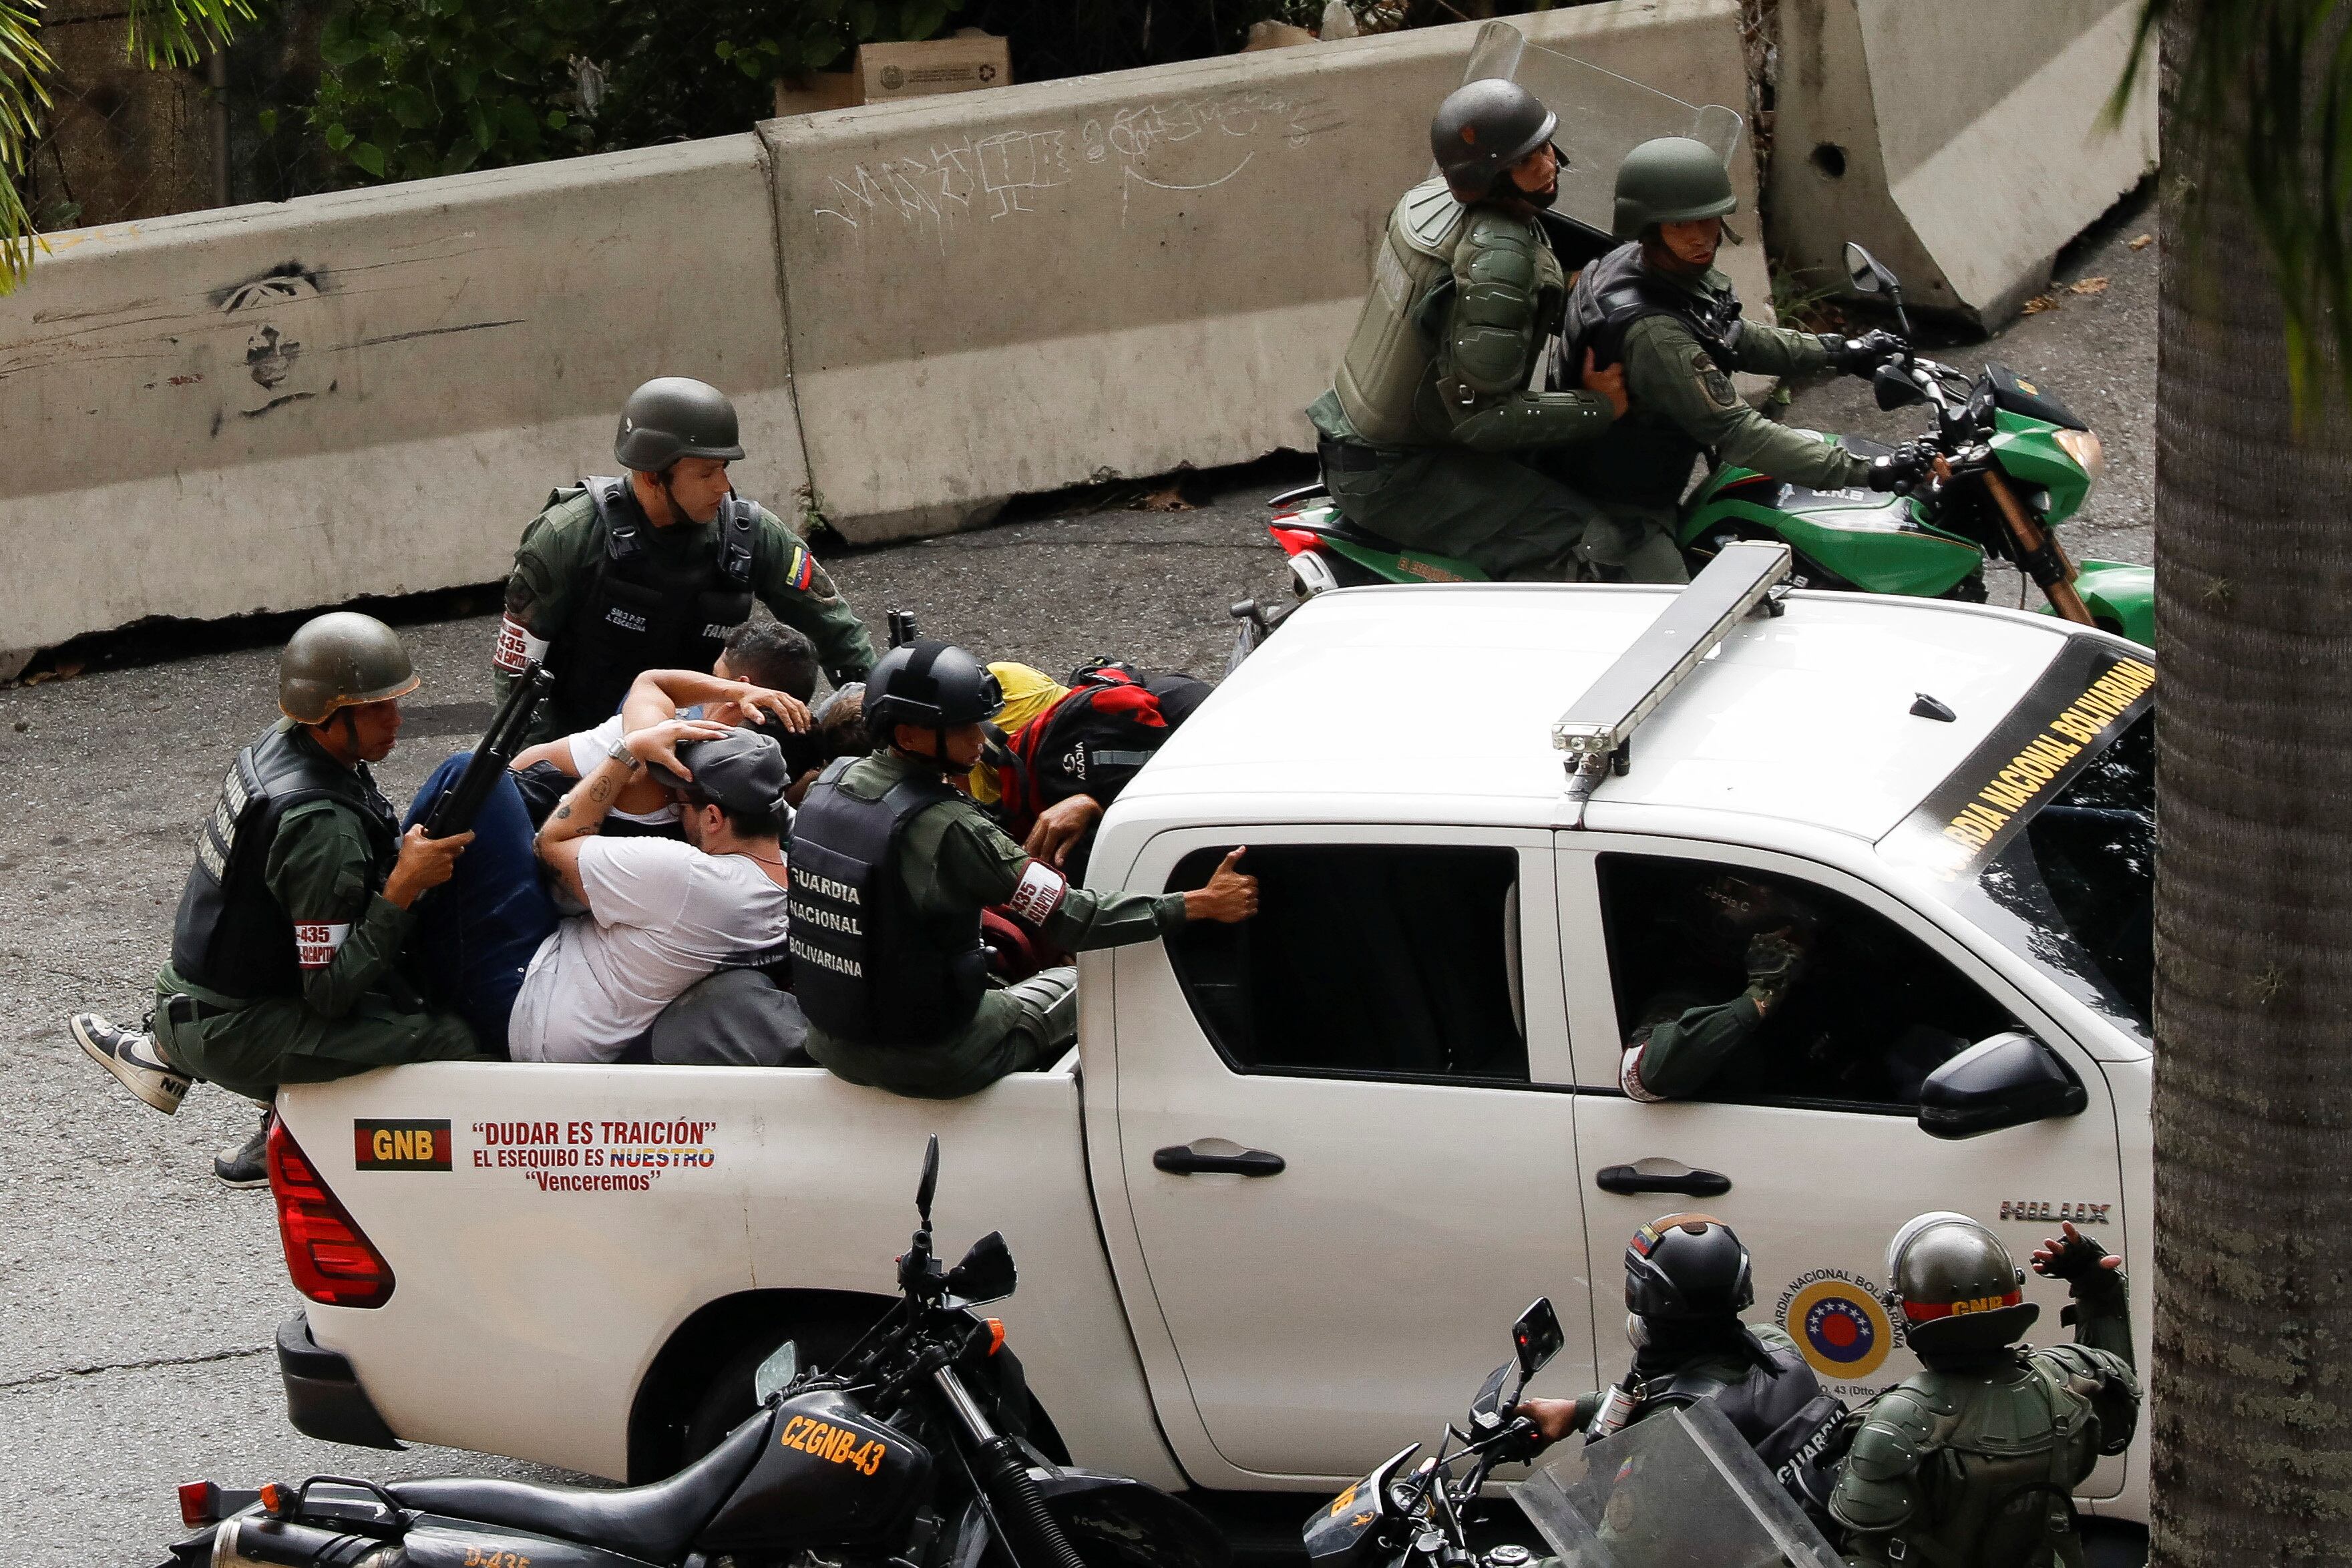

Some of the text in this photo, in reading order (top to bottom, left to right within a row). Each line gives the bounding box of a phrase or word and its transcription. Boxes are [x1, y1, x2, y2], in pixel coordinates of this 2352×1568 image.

[703, 624, 731, 638] FAN
[1978, 733, 2082, 813] NACIONAL
[2049, 656, 2156, 745] BOLIVARIANA
[1074, 741, 1087, 780] ACADIA
[791, 867, 861, 906] GUARDIA
[789, 900, 863, 936] NACIONAL
[789, 936, 863, 978] BOLIVARIANA
[373, 1129, 434, 1161] GNB
[568, 1122, 594, 1145] ES
[473, 1148, 715, 1169] EL ESEQUIBO ES NUESTRO
[1999, 1200, 2111, 1225] HILUX
[1788, 1268, 1851, 1296] NACIONAL
[1952, 1296, 2003, 1316] GNB
[1833, 1385, 1846, 1394] 43
[781, 1415, 887, 1475] CZGNB-43
